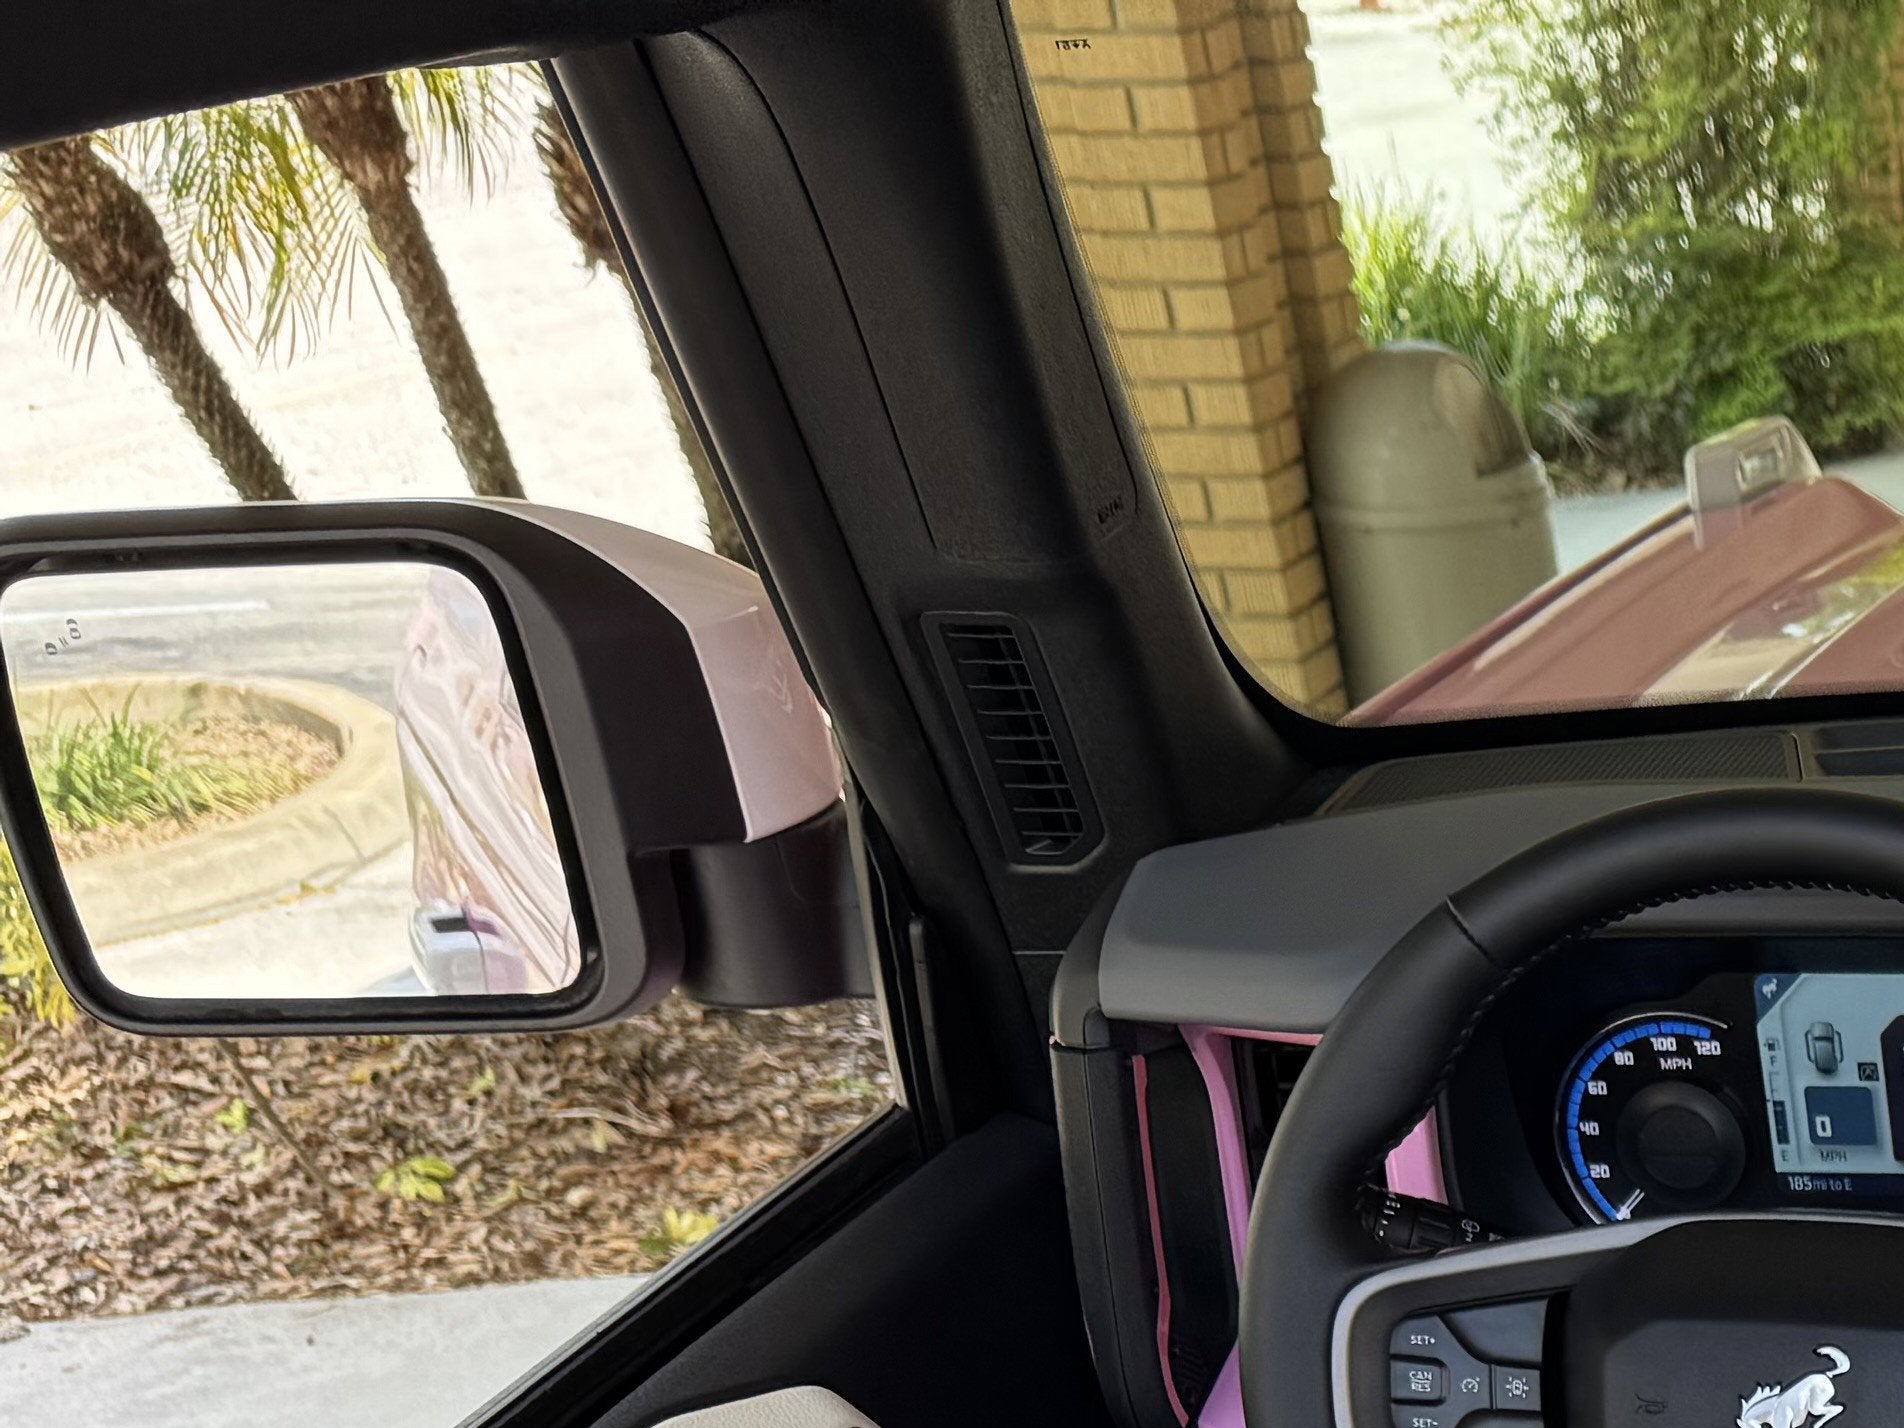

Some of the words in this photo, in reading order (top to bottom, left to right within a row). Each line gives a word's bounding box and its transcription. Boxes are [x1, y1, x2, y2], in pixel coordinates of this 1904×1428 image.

[1649, 1036, 1677, 1052] 100
[1693, 1040, 1721, 1056] 120
[1613, 1050, 1635, 1066] 80
[1659, 1057, 1693, 1070] MPH
[1587, 1080, 1608, 1096] 60
[1579, 1121, 1600, 1136] 40
[1815, 1115, 1832, 1138] 0
[1819, 1149, 1848, 1162] MPH
[1589, 1163, 1611, 1178] 20
